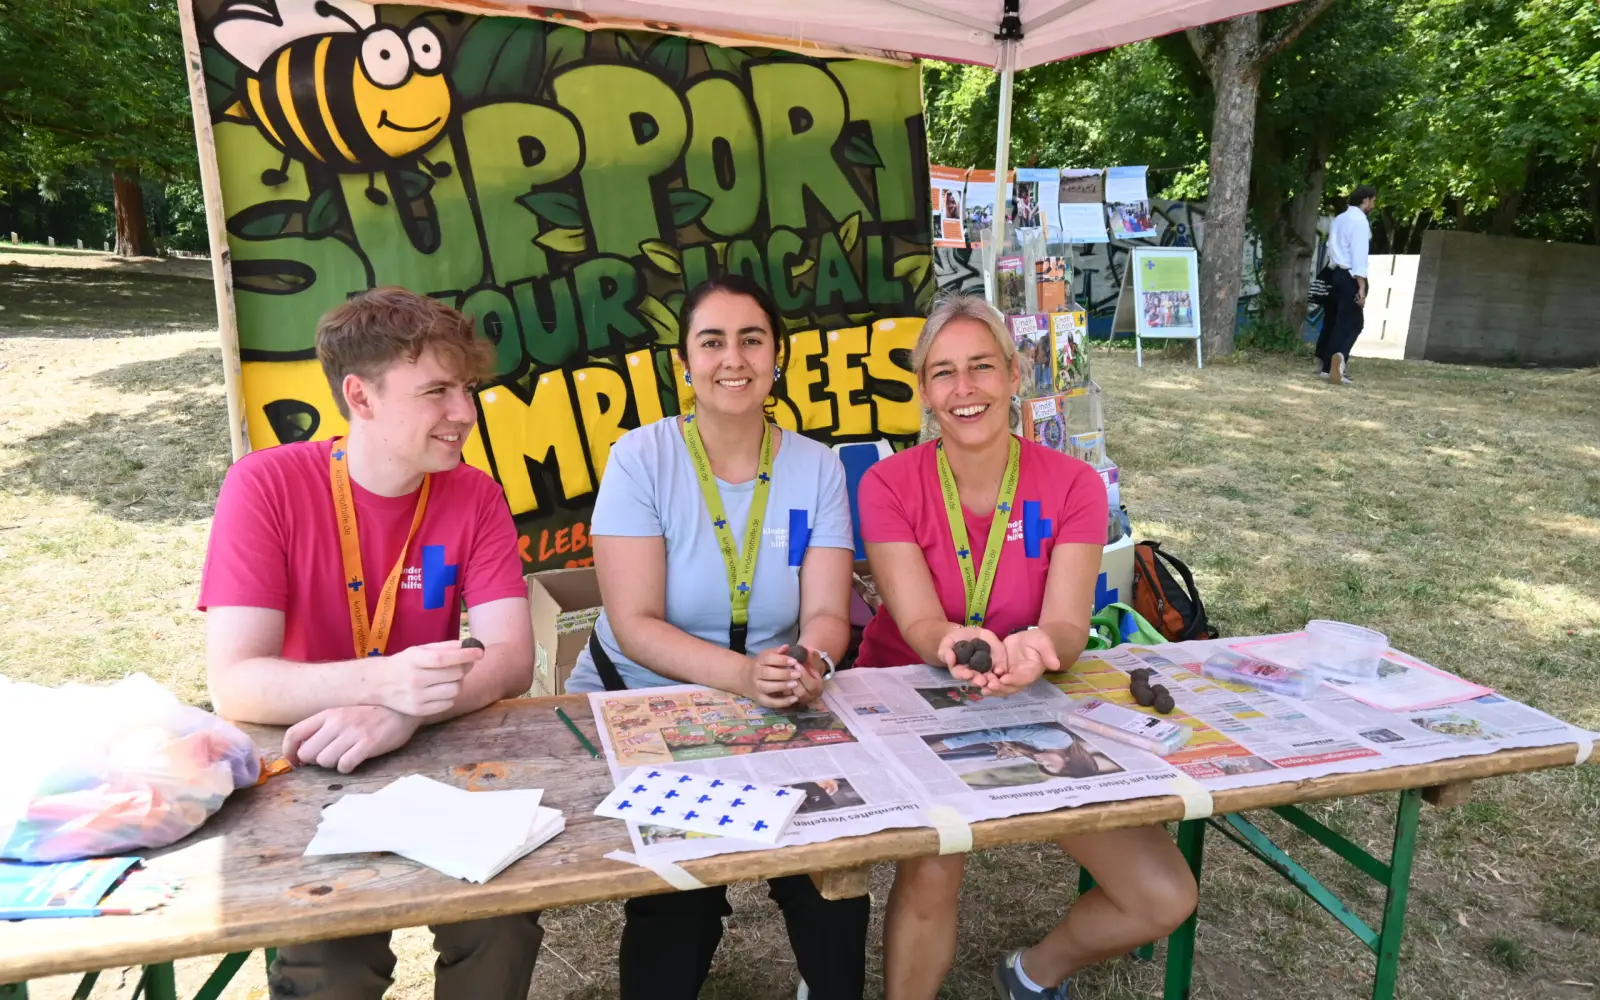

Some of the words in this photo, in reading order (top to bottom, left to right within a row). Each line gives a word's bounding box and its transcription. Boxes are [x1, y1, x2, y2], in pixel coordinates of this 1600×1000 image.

[214, 60, 926, 358] SUPPORT
[441, 256, 648, 376] OUR
[335, 469, 352, 536] kindernothilfe.de
[539, 522, 593, 562] LEB
[743, 518, 760, 574] kindernothilfe.de
[400, 581, 423, 589] hilfe
[407, 574, 422, 582] not
[376, 575, 397, 640] kindernothilfe.de
[1076, 784, 1091, 792] die
[1145, 772, 1177, 781] Handy
[988, 788, 1045, 801] Ablenkung
[792, 815, 847, 827] Vorgehen
